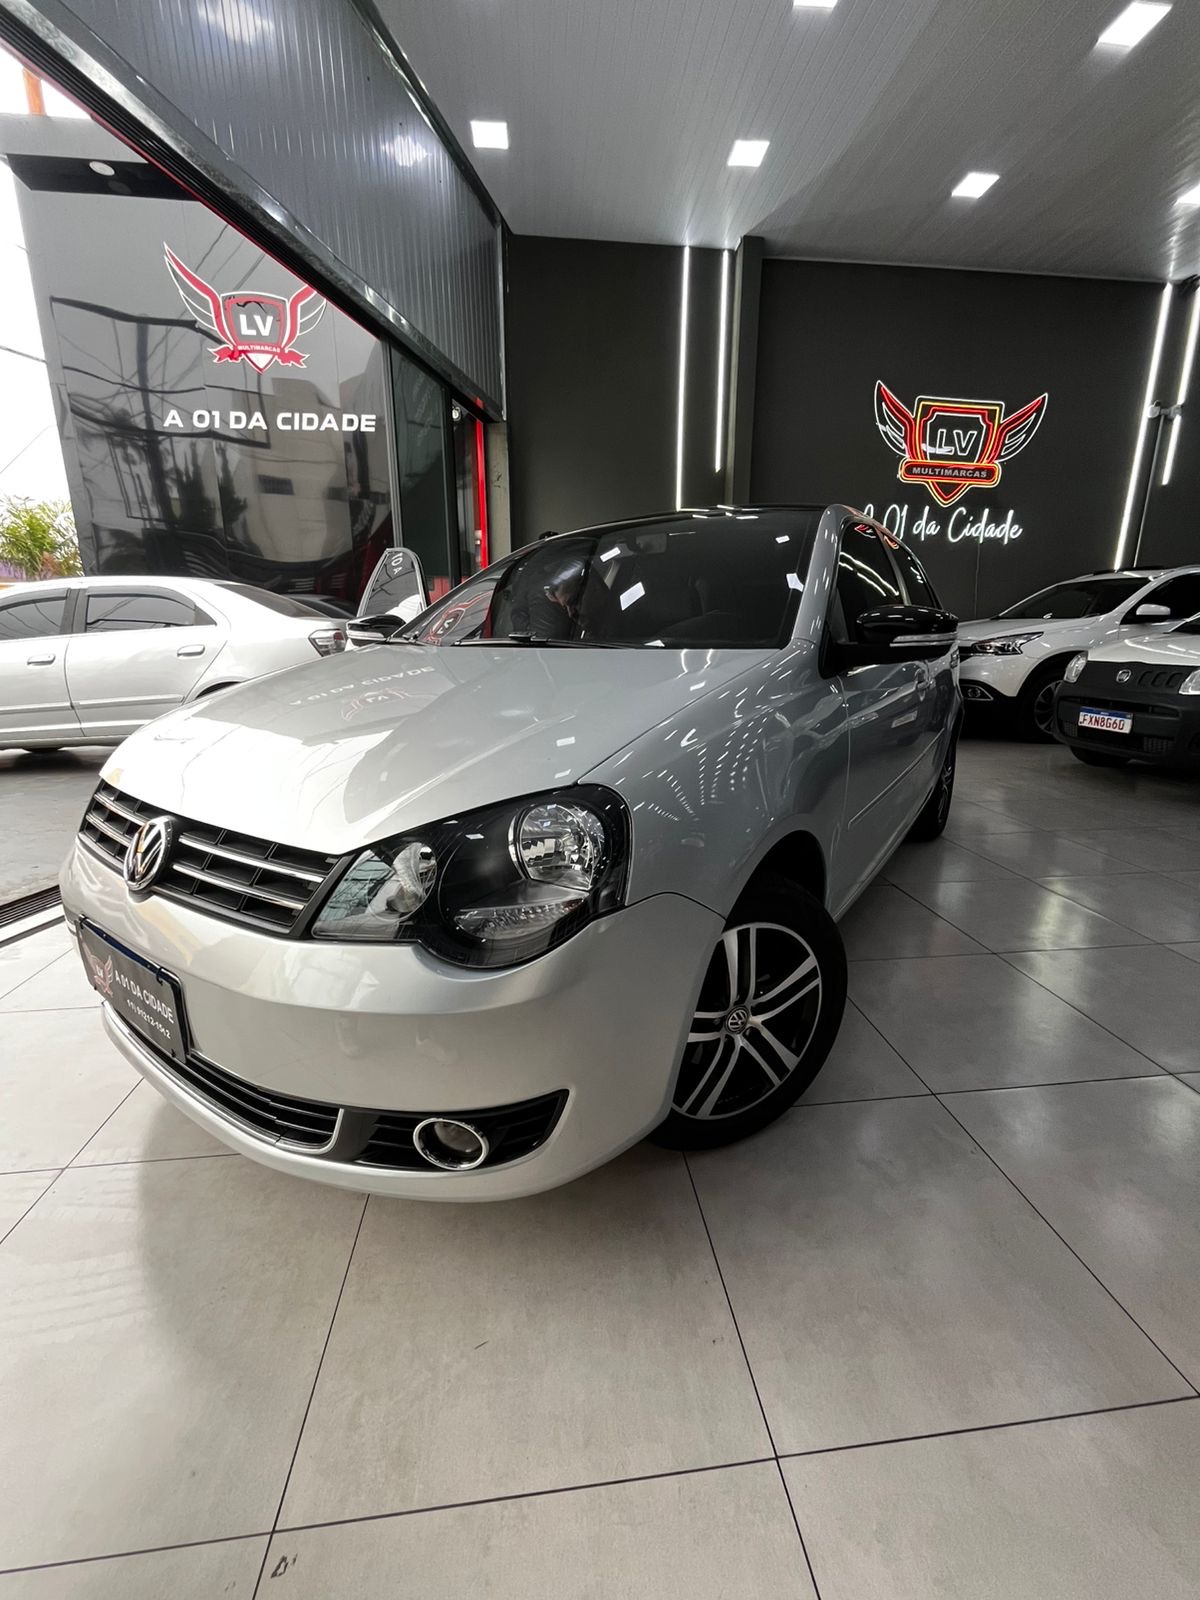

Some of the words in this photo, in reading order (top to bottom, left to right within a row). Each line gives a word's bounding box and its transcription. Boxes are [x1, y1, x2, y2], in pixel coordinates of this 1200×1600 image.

[240, 314, 274, 337] LV
[163, 409, 184, 428] A
[192, 410, 220, 429] 01
[229, 411, 268, 430] DA
[276, 412, 377, 432] CIDADE
[936, 429, 978, 456] LV
[912, 467, 988, 478] MULTIMARCAS
[912, 505, 941, 541] da
[947, 507, 1023, 545] Cidade
[130, 981, 143, 1000] DA
[143, 990, 174, 1024] CIDADE
